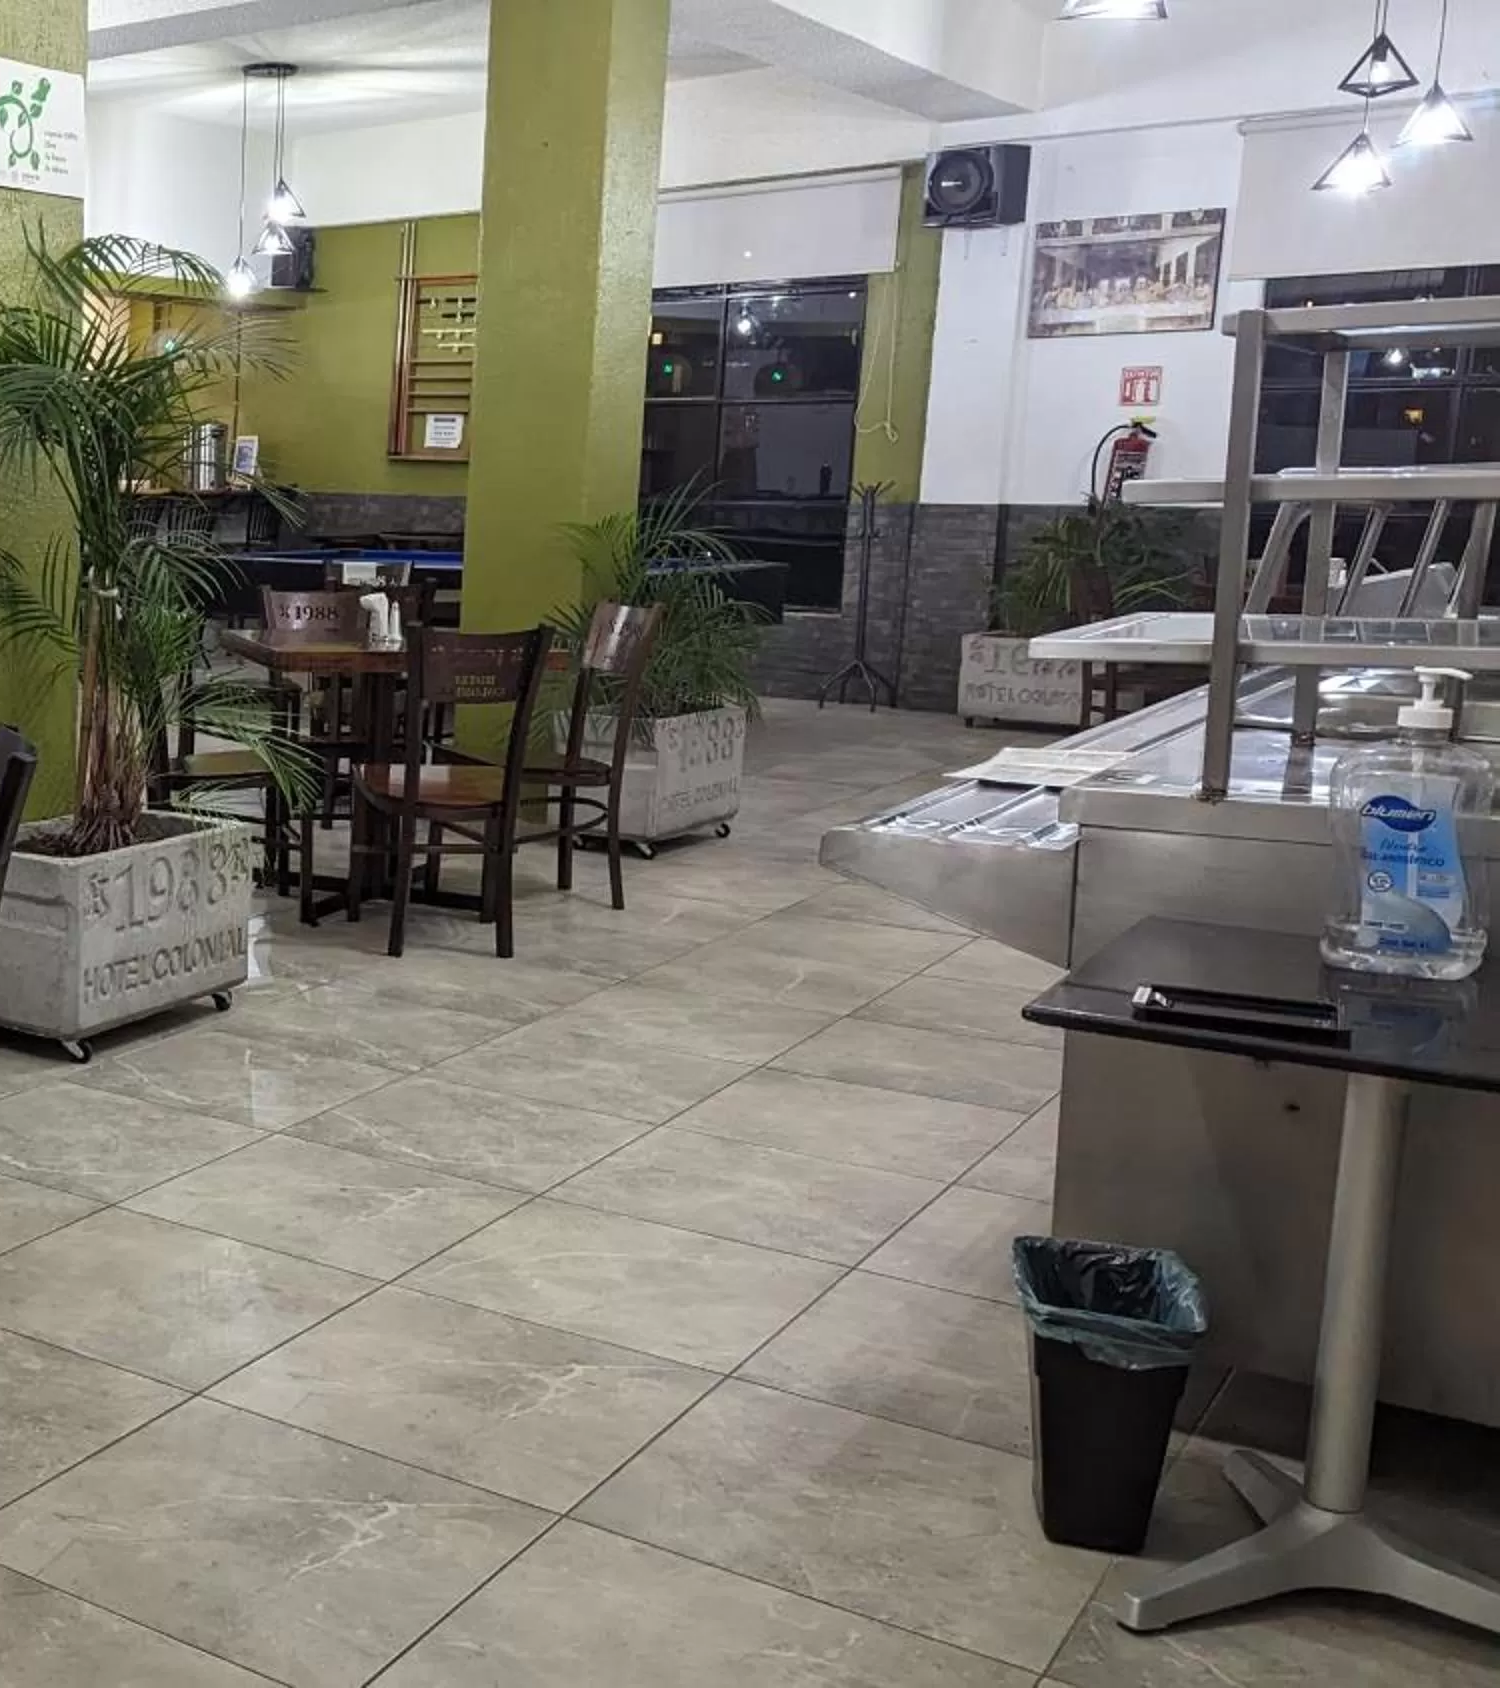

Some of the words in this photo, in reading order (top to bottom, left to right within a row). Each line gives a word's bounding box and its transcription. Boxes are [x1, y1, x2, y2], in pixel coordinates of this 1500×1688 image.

[113, 843, 229, 932] 1988
[84, 954, 151, 1004] HOTEL
[152, 927, 247, 981] COLONIAL
